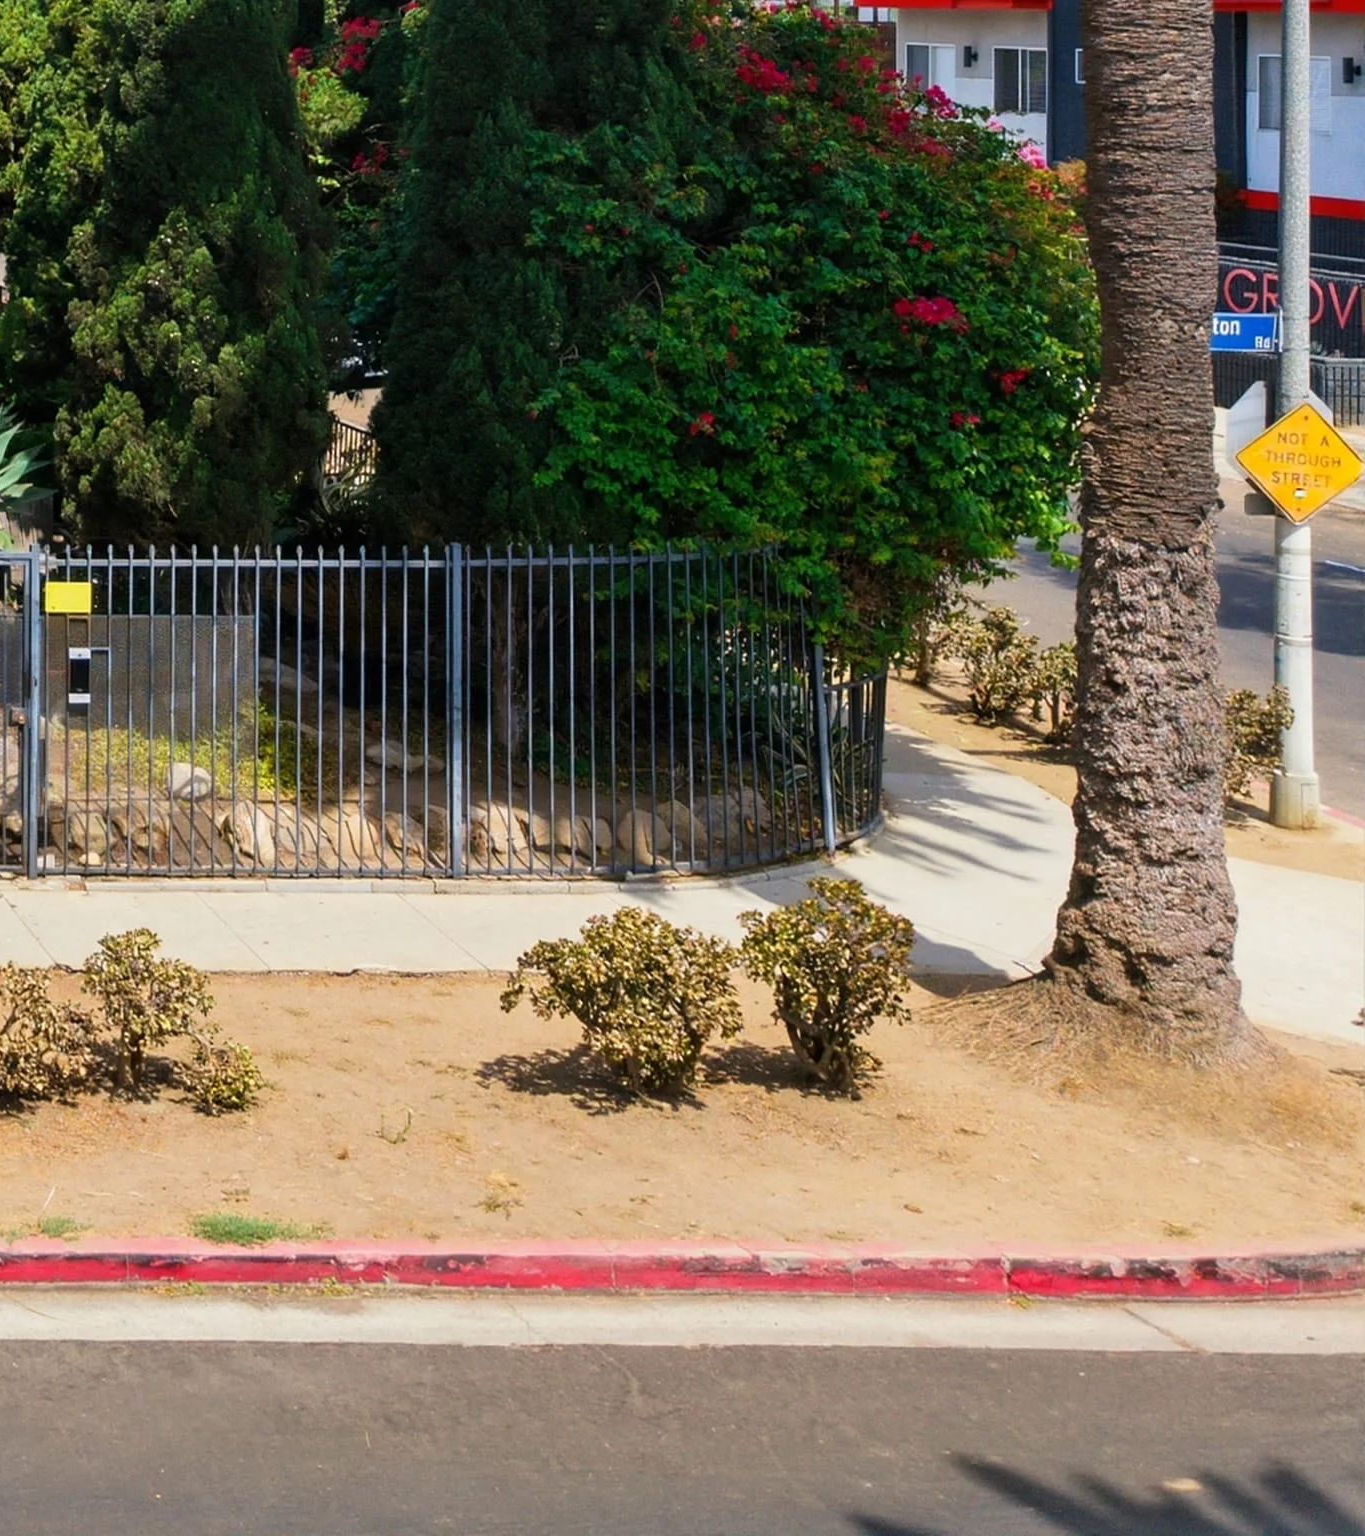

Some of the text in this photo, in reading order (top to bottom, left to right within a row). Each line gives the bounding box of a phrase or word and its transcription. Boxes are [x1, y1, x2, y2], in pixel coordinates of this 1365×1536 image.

[1212, 317, 1241, 336] ton
[1277, 432, 1330, 447] NOT A
[1264, 449, 1342, 468] THROUGH
[1271, 470, 1332, 488] STREET
